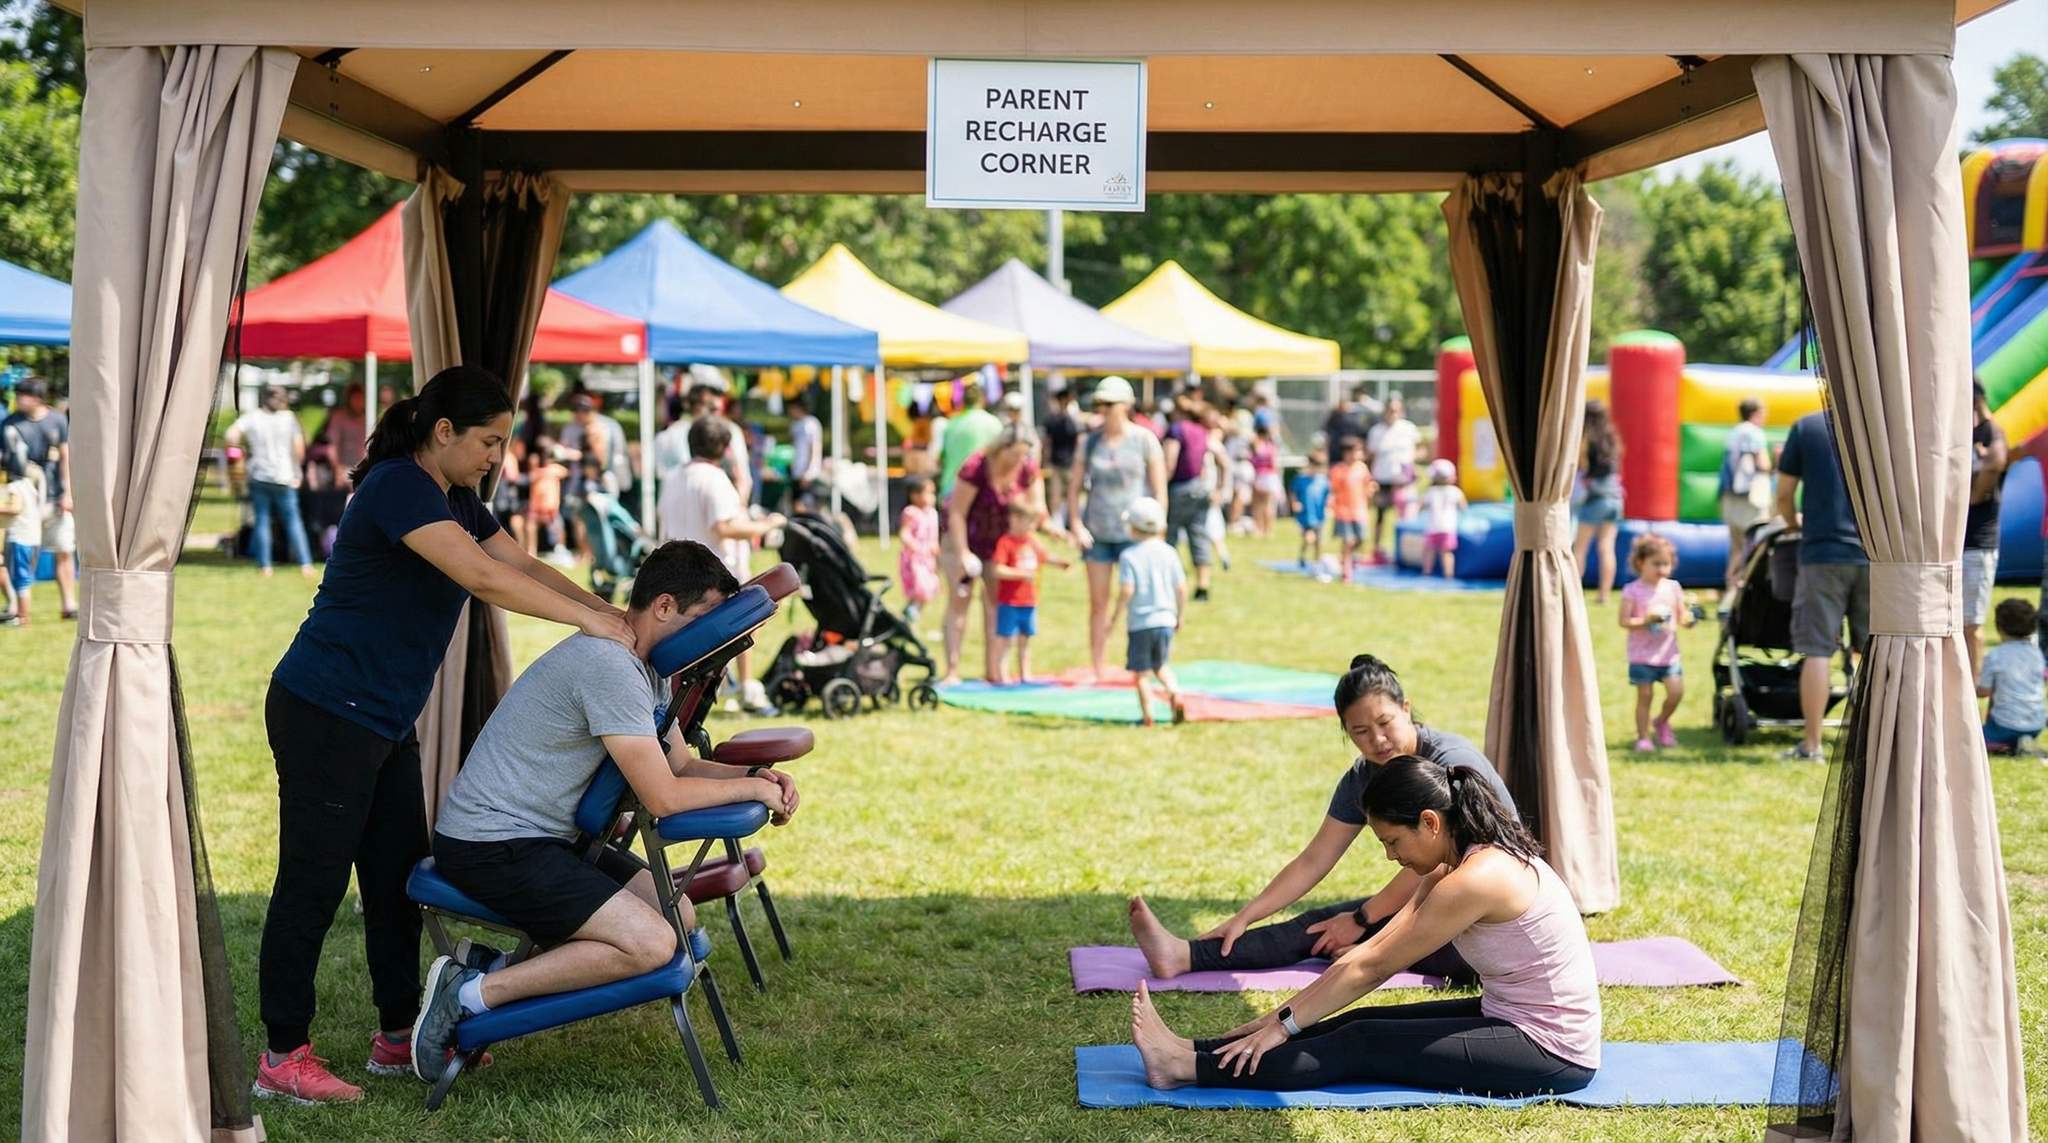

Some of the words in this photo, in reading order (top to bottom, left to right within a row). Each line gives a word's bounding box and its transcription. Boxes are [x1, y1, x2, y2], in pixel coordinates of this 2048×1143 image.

[986, 88, 1090, 111] PARENT
[965, 120, 1107, 143] RECHARGE
[980, 152, 1091, 175] CORNER
